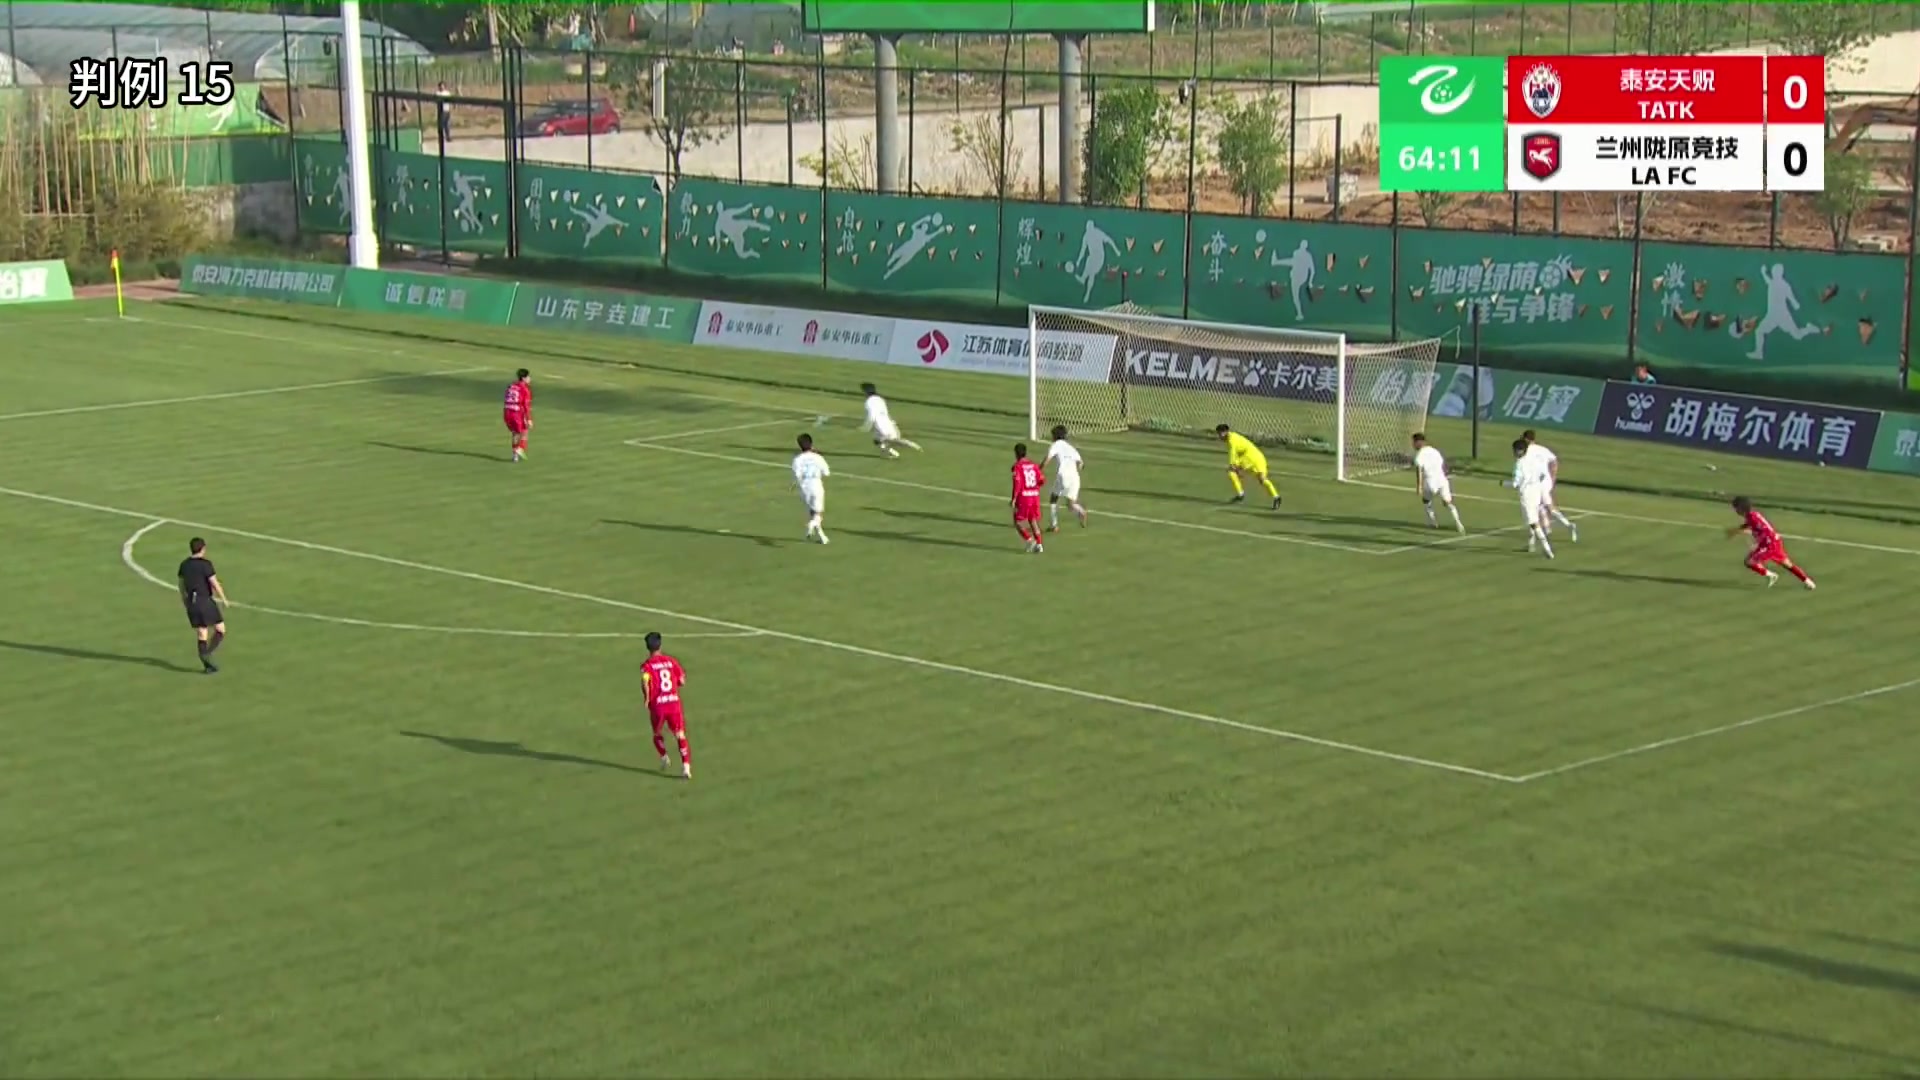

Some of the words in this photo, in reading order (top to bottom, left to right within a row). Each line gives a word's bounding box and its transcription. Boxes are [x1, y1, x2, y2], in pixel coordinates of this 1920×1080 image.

[1016, 217, 1036, 266] 辉煌
[1208, 229, 1227, 283] 奋斗
[1125, 349, 1241, 384] KELME
[1268, 361, 1338, 392] 卡尔美
[1614, 416, 1654, 434] hummel
[1664, 397, 1857, 458] 胡梅尔体育
[1894, 428, 1920, 457] 泰
[659, 669, 673, 692] 8
